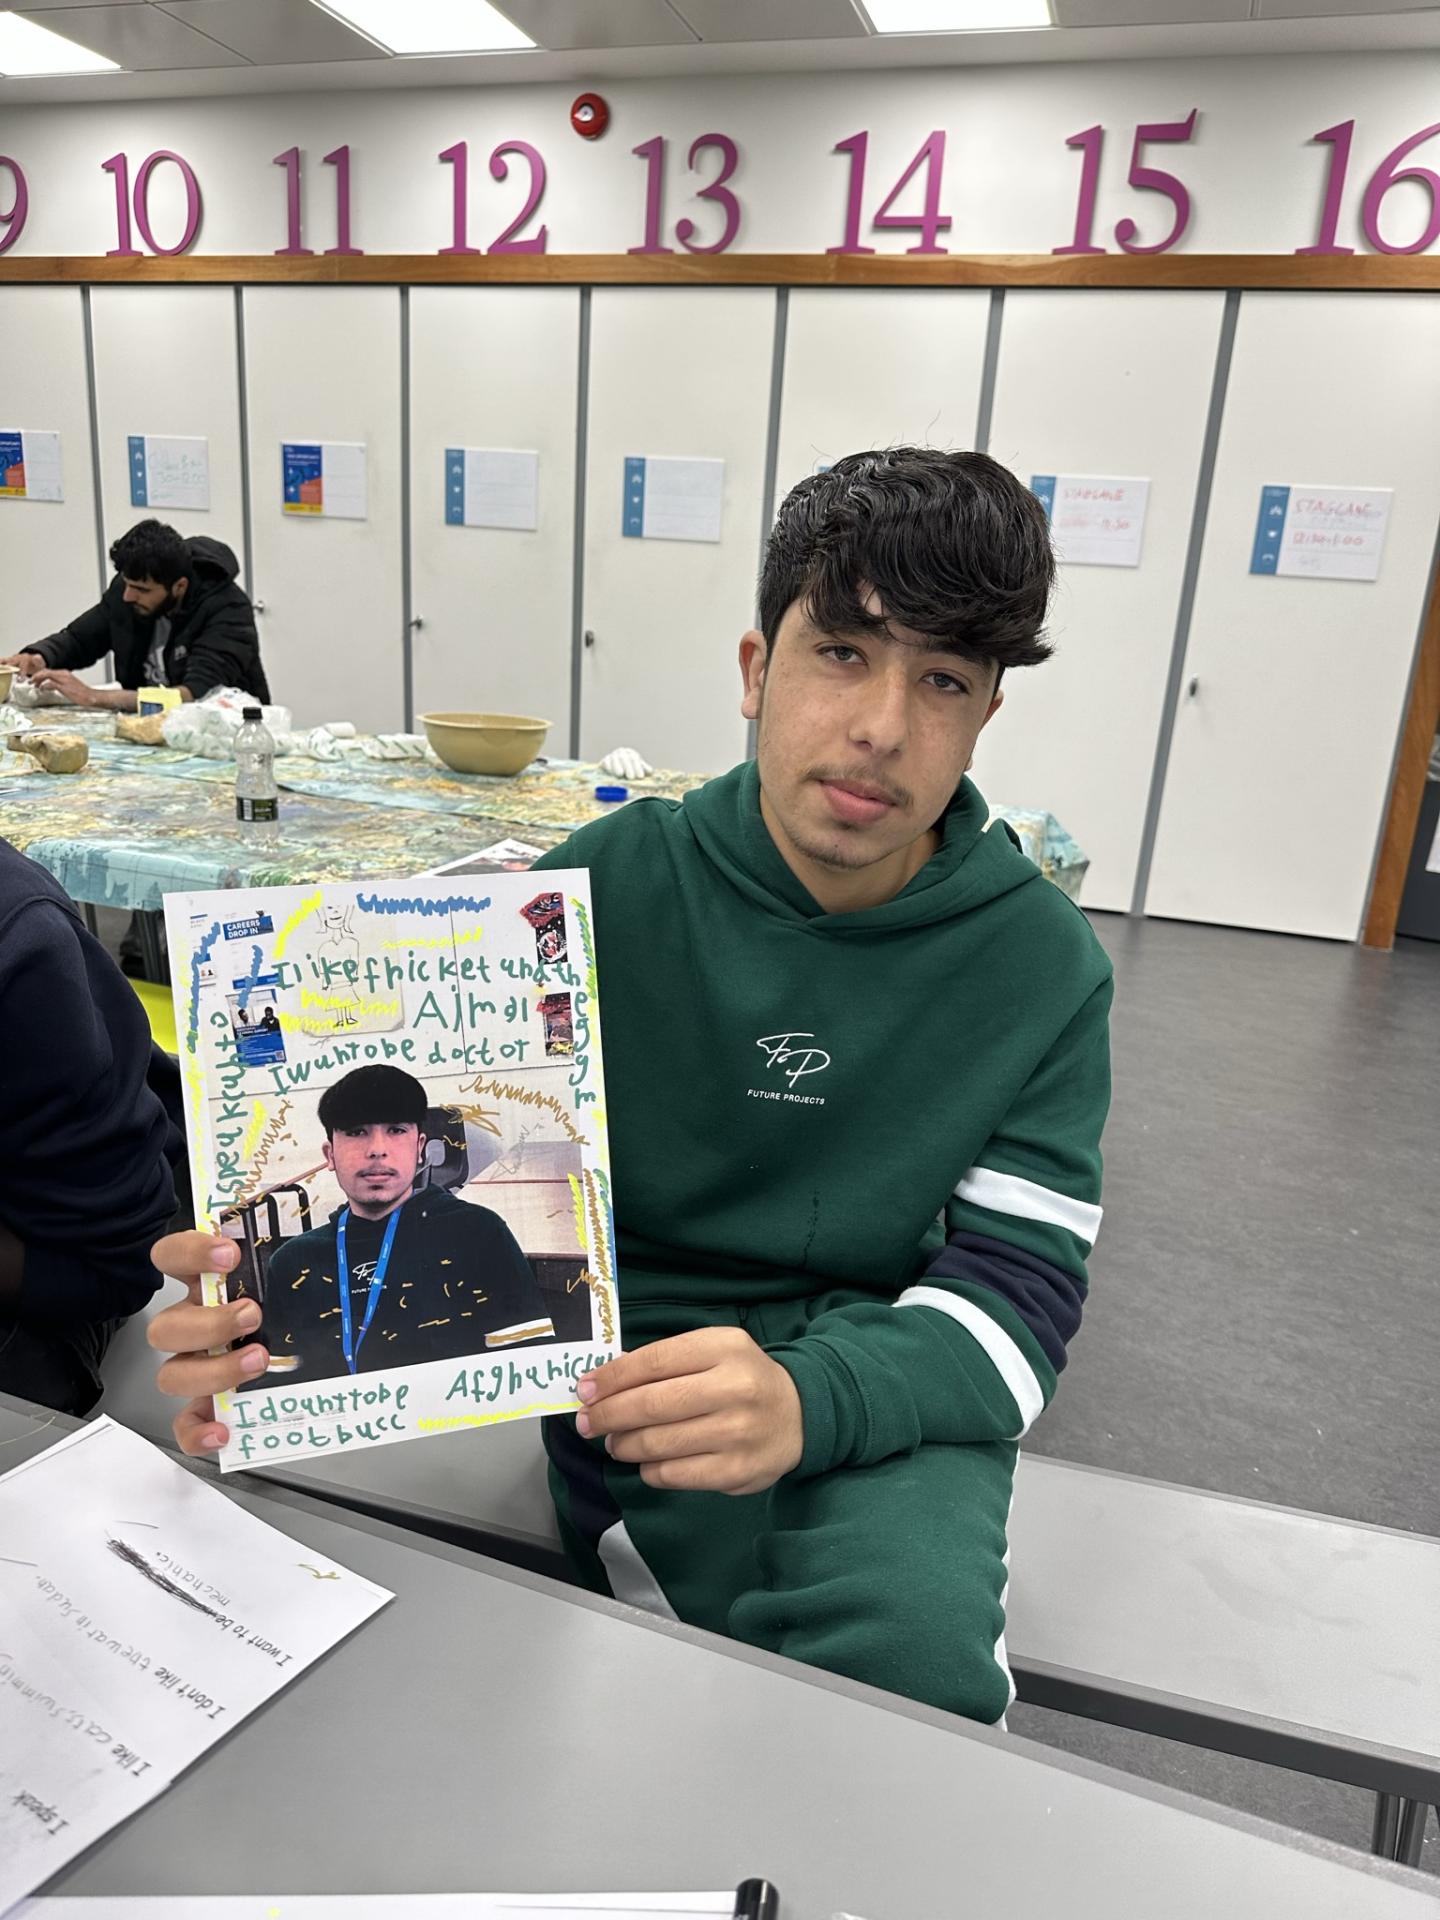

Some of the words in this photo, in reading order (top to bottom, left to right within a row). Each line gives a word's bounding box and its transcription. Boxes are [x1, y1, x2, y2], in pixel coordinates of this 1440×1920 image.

[826, 131, 952, 254] 14
[1052, 108, 1198, 254] 15
[1295, 120, 1440, 255] 16
[101, 150, 201, 256] 10
[273, 145, 363, 255] 11
[438, 140, 547, 254] 12
[628, 133, 741, 255] 13
[227, 919, 261, 931] CAREERS
[228, 929, 249, 939] DROP
[250, 927, 259, 935] IN
[747, 1088, 781, 1101] FUTURE
[783, 1093, 826, 1106] PROJECTS
[232, 1624, 249, 1639] to
[247, 1634, 281, 1659] want
[276, 1654, 293, 1667] I
[154, 1666, 181, 1690] like
[177, 1683, 214, 1710] don't
[207, 1705, 226, 1720] I
[111, 1743, 140, 1769] like
[132, 1761, 152, 1777] I
[48, 1819, 70, 1836] I
